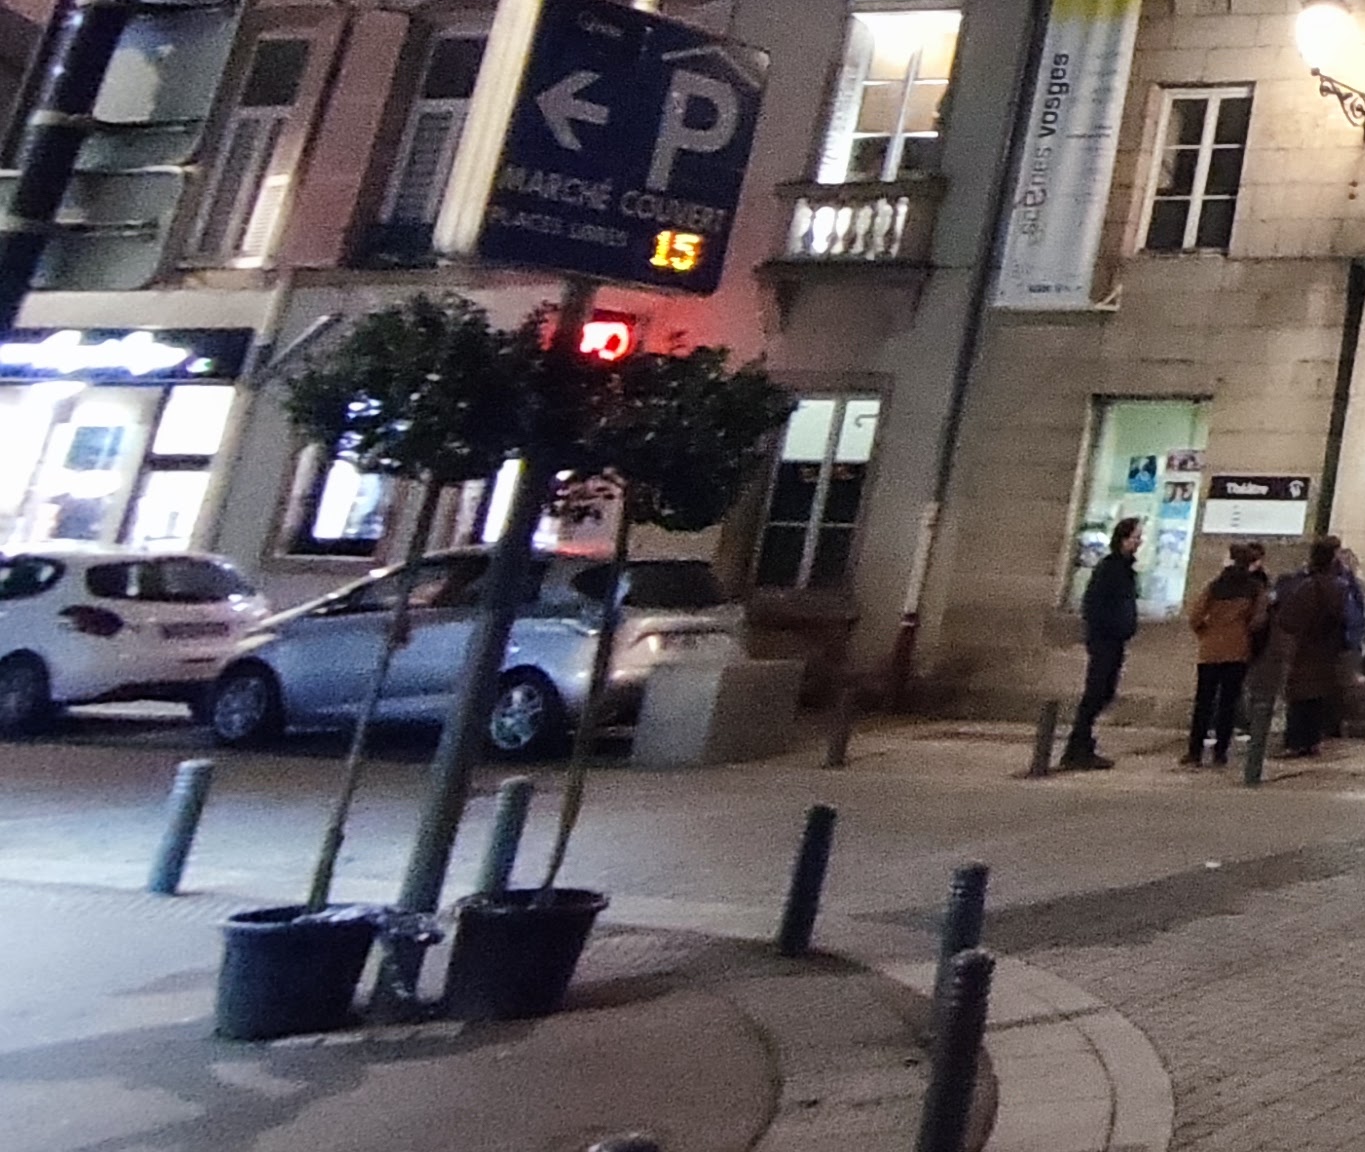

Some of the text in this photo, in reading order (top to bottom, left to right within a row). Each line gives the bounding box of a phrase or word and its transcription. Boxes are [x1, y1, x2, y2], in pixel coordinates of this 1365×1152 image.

[645, 68, 740, 191] P
[1037, 52, 1071, 139] vosges
[497, 163, 728, 233] MARCHÉ COUVERT
[649, 229, 705, 272] 15
